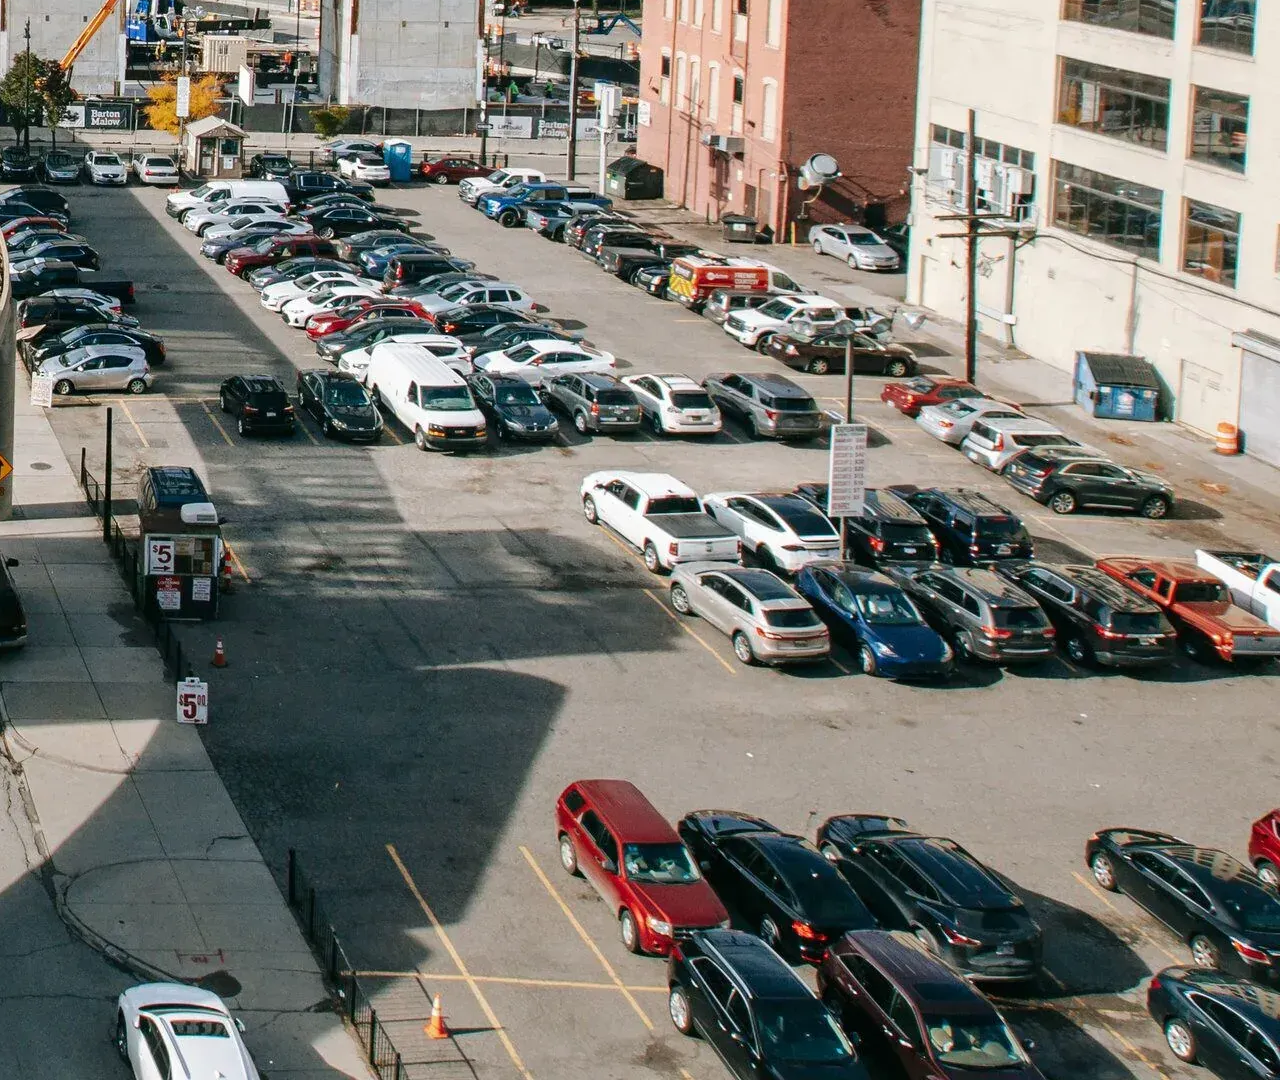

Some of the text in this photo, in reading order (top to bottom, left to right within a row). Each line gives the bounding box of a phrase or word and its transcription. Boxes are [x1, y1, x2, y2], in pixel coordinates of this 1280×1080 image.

[91, 109, 121, 118] Barton
[91, 118, 121, 126] Malow
[538, 120, 569, 128] Barton
[152, 545, 171, 563] $5
